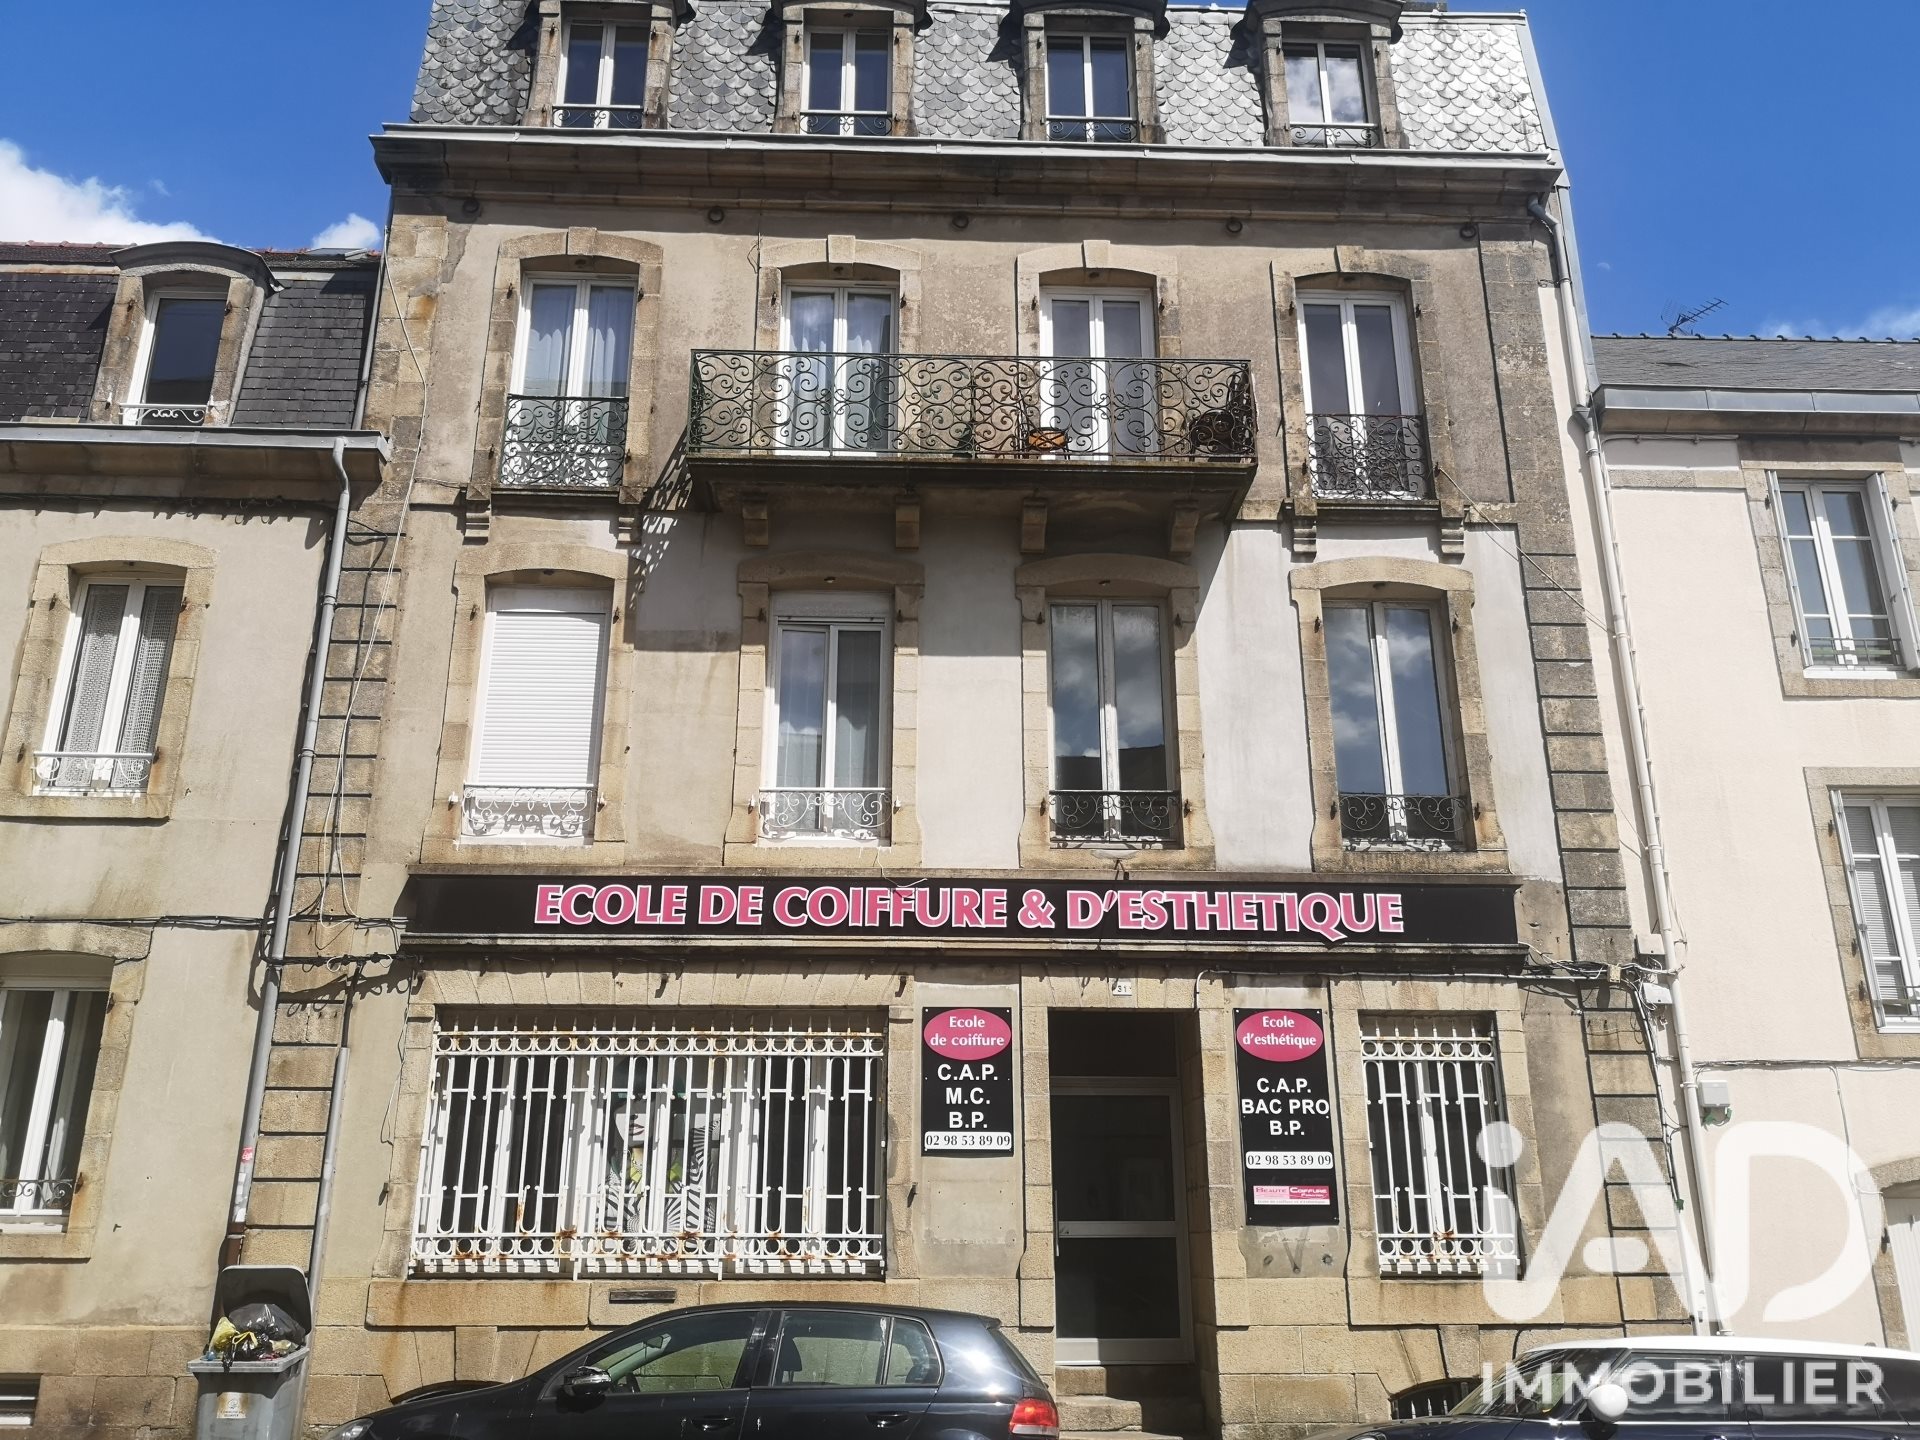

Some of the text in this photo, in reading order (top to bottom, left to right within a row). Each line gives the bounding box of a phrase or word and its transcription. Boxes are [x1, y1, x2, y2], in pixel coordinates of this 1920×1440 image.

[534, 884, 1404, 942] ECOLE DE COIFFURE & D'ESTHETIQUE
[949, 1015, 986, 1028] Ecole
[1262, 1015, 1295, 1028] Ecole
[930, 1033, 1005, 1046] de coiffure
[1242, 1032, 1317, 1049] d'esthétique
[937, 1063, 999, 1081] C.A.P.
[1256, 1077, 1312, 1093] C.A.P.
[945, 1087, 991, 1105] M.C.
[1241, 1098, 1330, 1115] BAC PRO
[949, 1111, 988, 1129] B.P.
[1269, 1120, 1305, 1136] B.P.
[926, 1135, 1010, 1146] 02 98 53 89 09
[1247, 1154, 1332, 1166] 02 98 53 89 09
